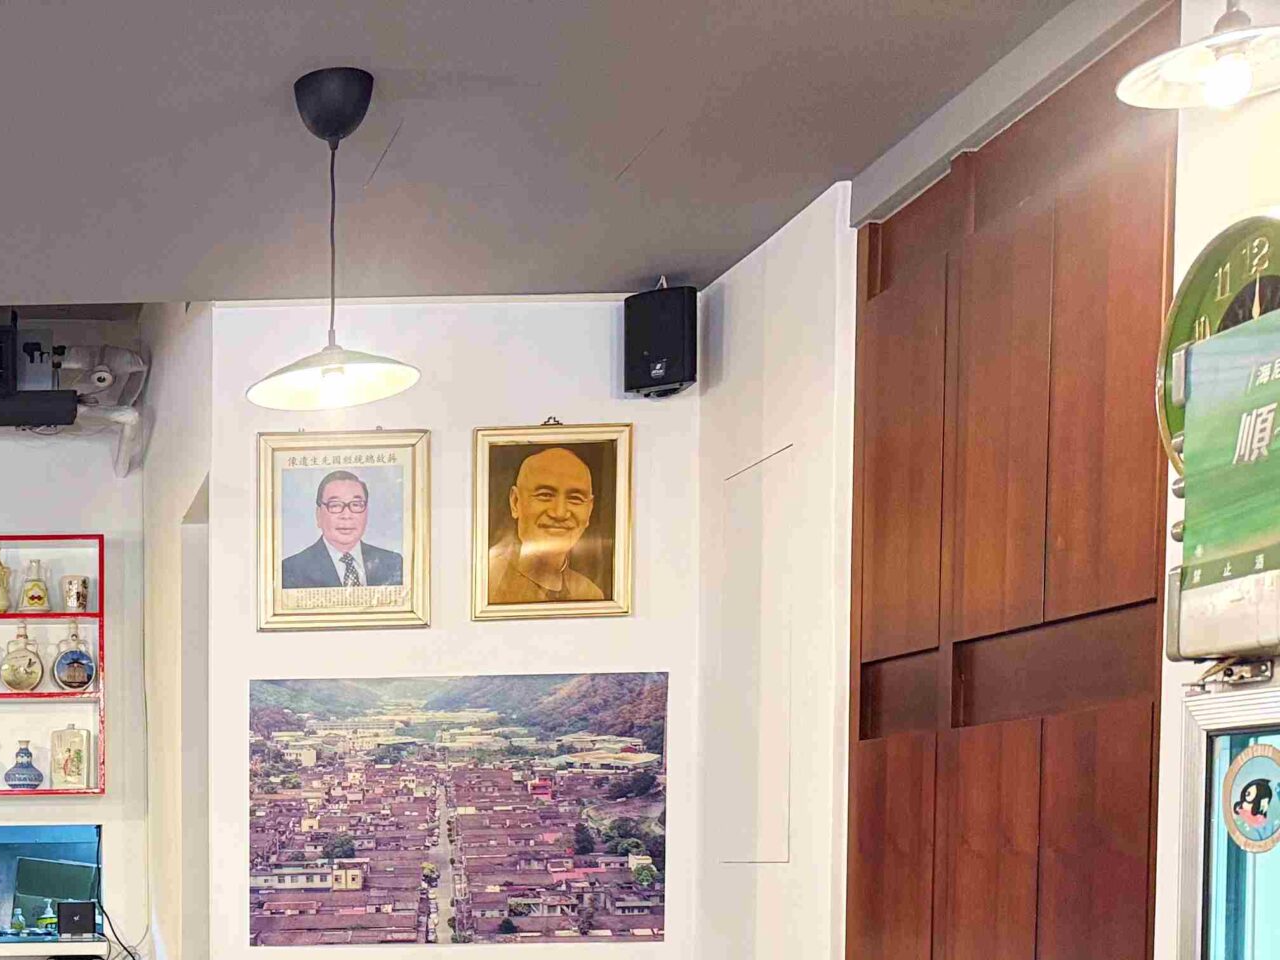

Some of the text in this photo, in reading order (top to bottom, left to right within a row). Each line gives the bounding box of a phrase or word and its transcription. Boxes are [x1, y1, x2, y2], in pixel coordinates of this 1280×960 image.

[1242, 237, 1270, 275] 12
[1215, 262, 1231, 301] 11
[1232, 402, 1280, 465] 順
